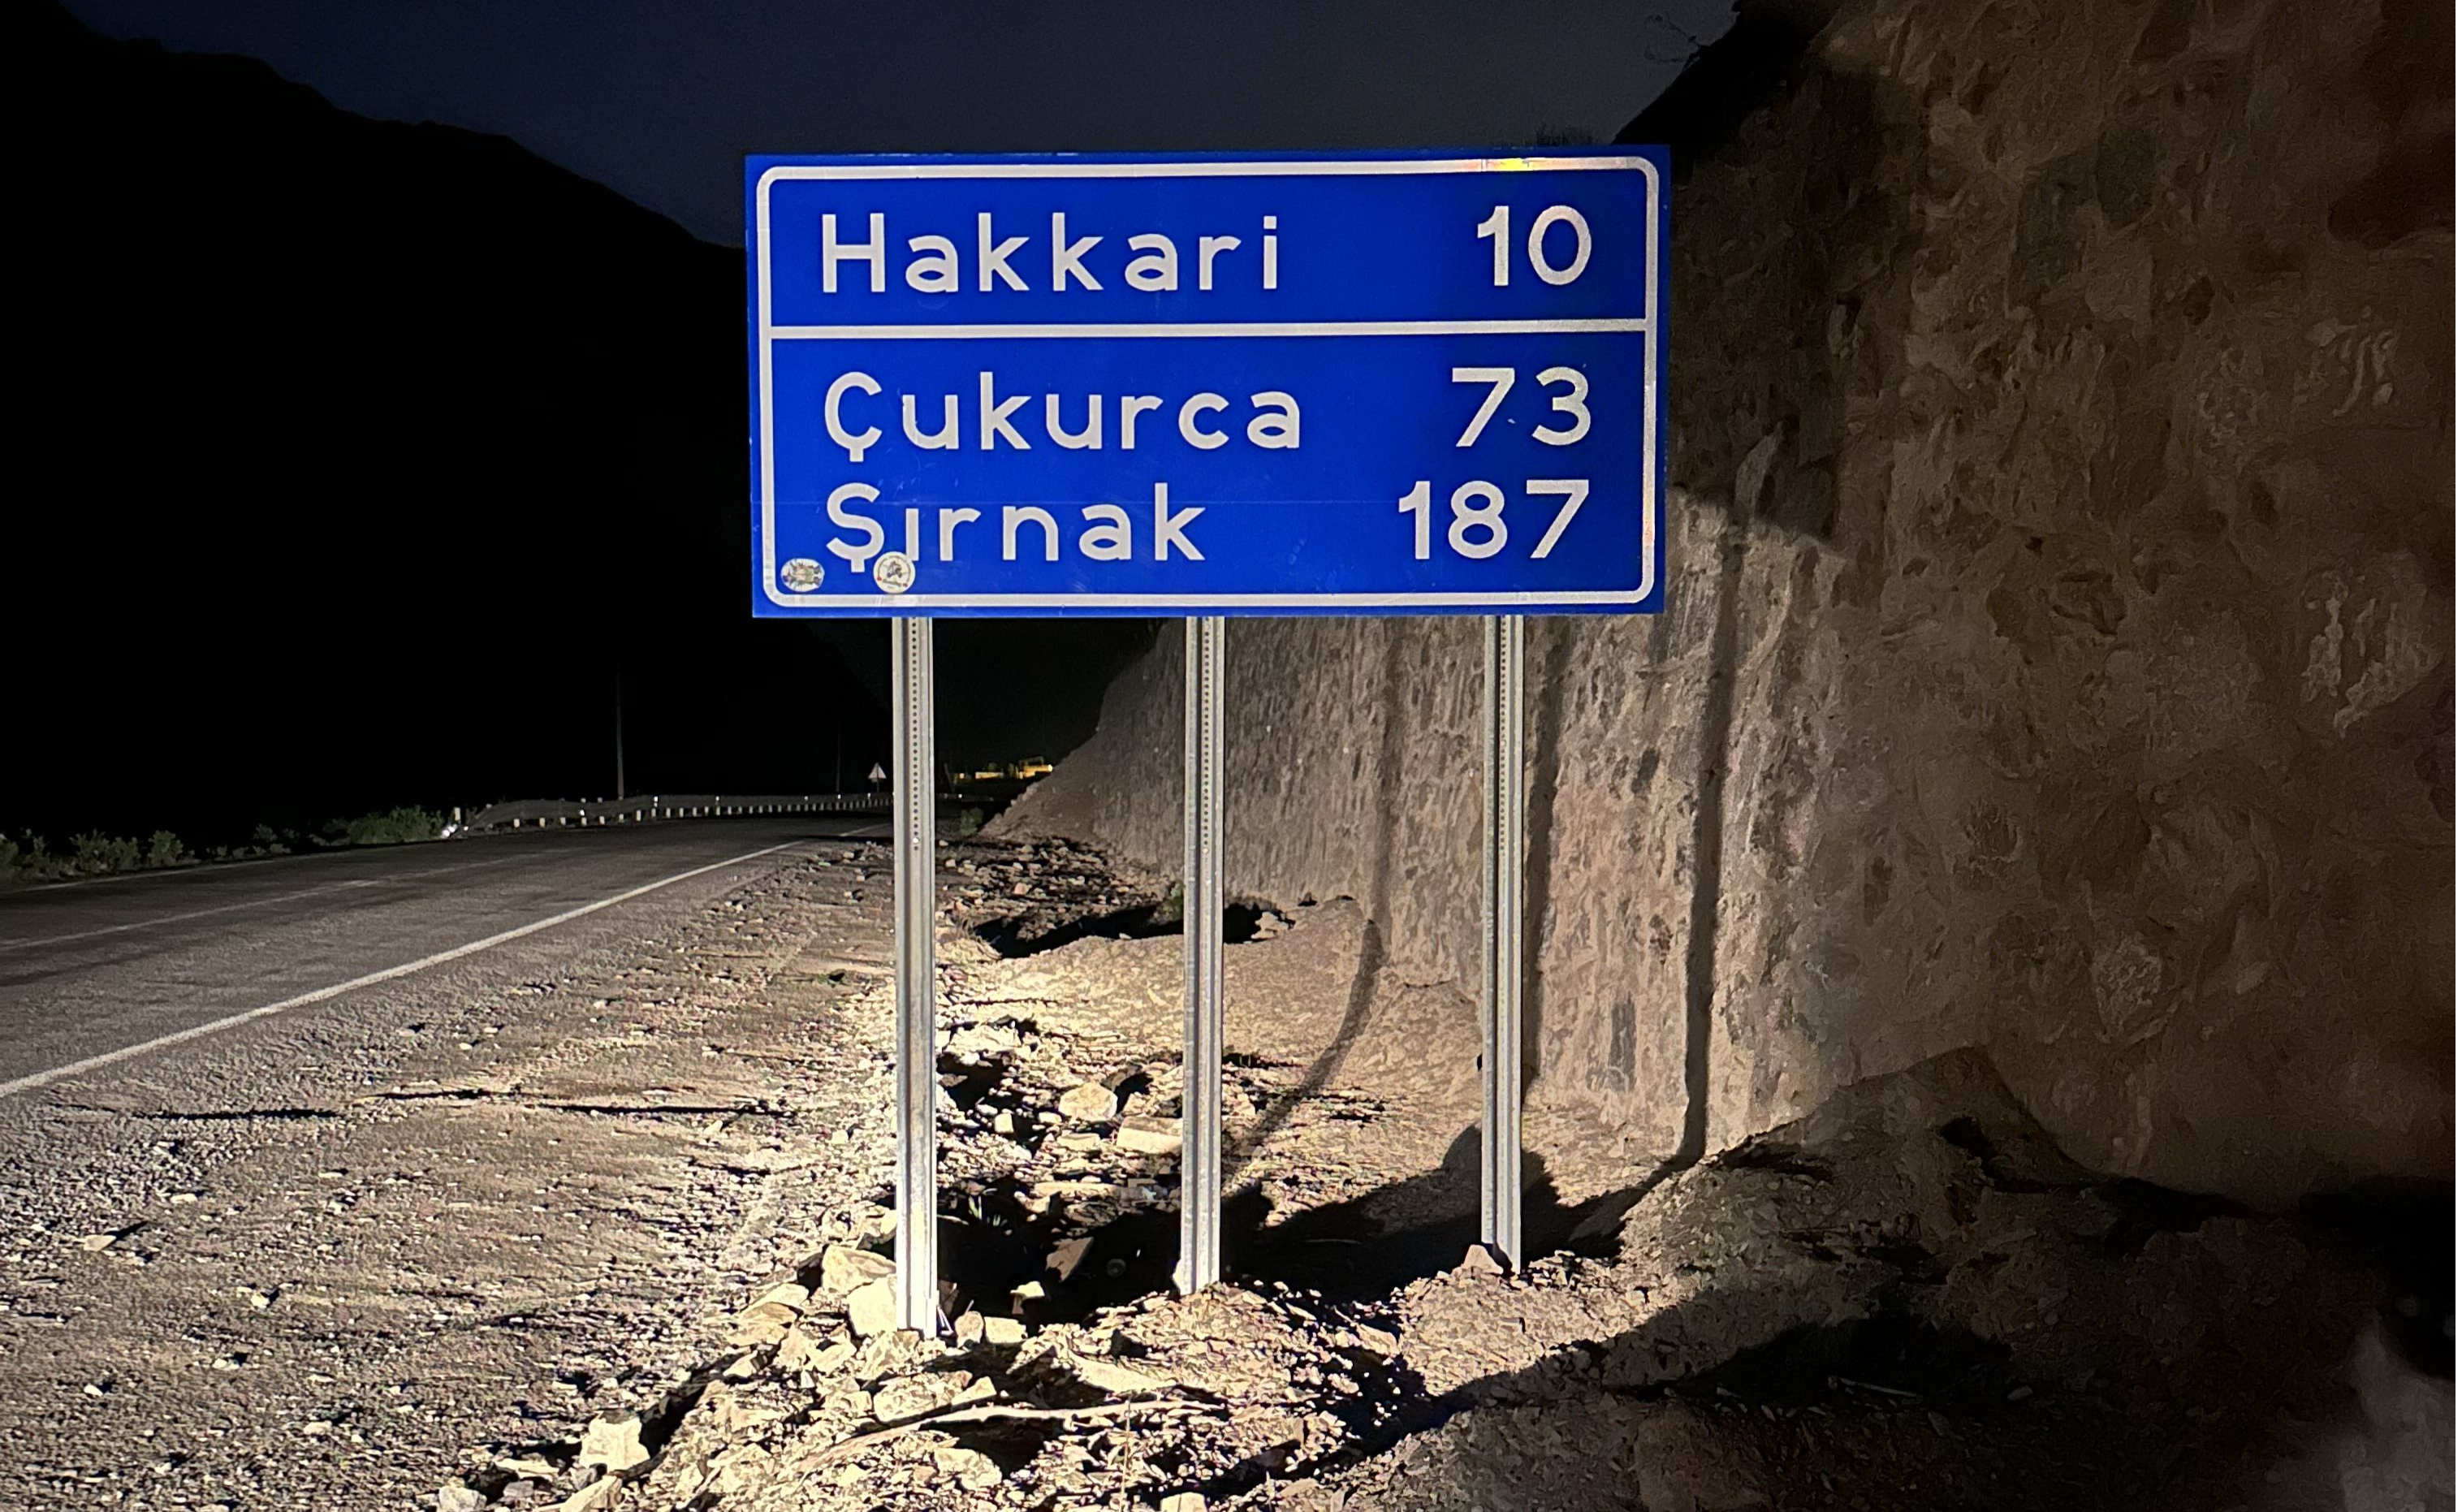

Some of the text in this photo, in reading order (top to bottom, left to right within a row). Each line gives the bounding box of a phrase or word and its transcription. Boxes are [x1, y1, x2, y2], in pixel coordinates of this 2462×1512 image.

[822, 205, 1592, 293] Hakkari 10
[824, 366, 1592, 463] Çukurca 73
[826, 479, 1589, 573] Şırnak 187
